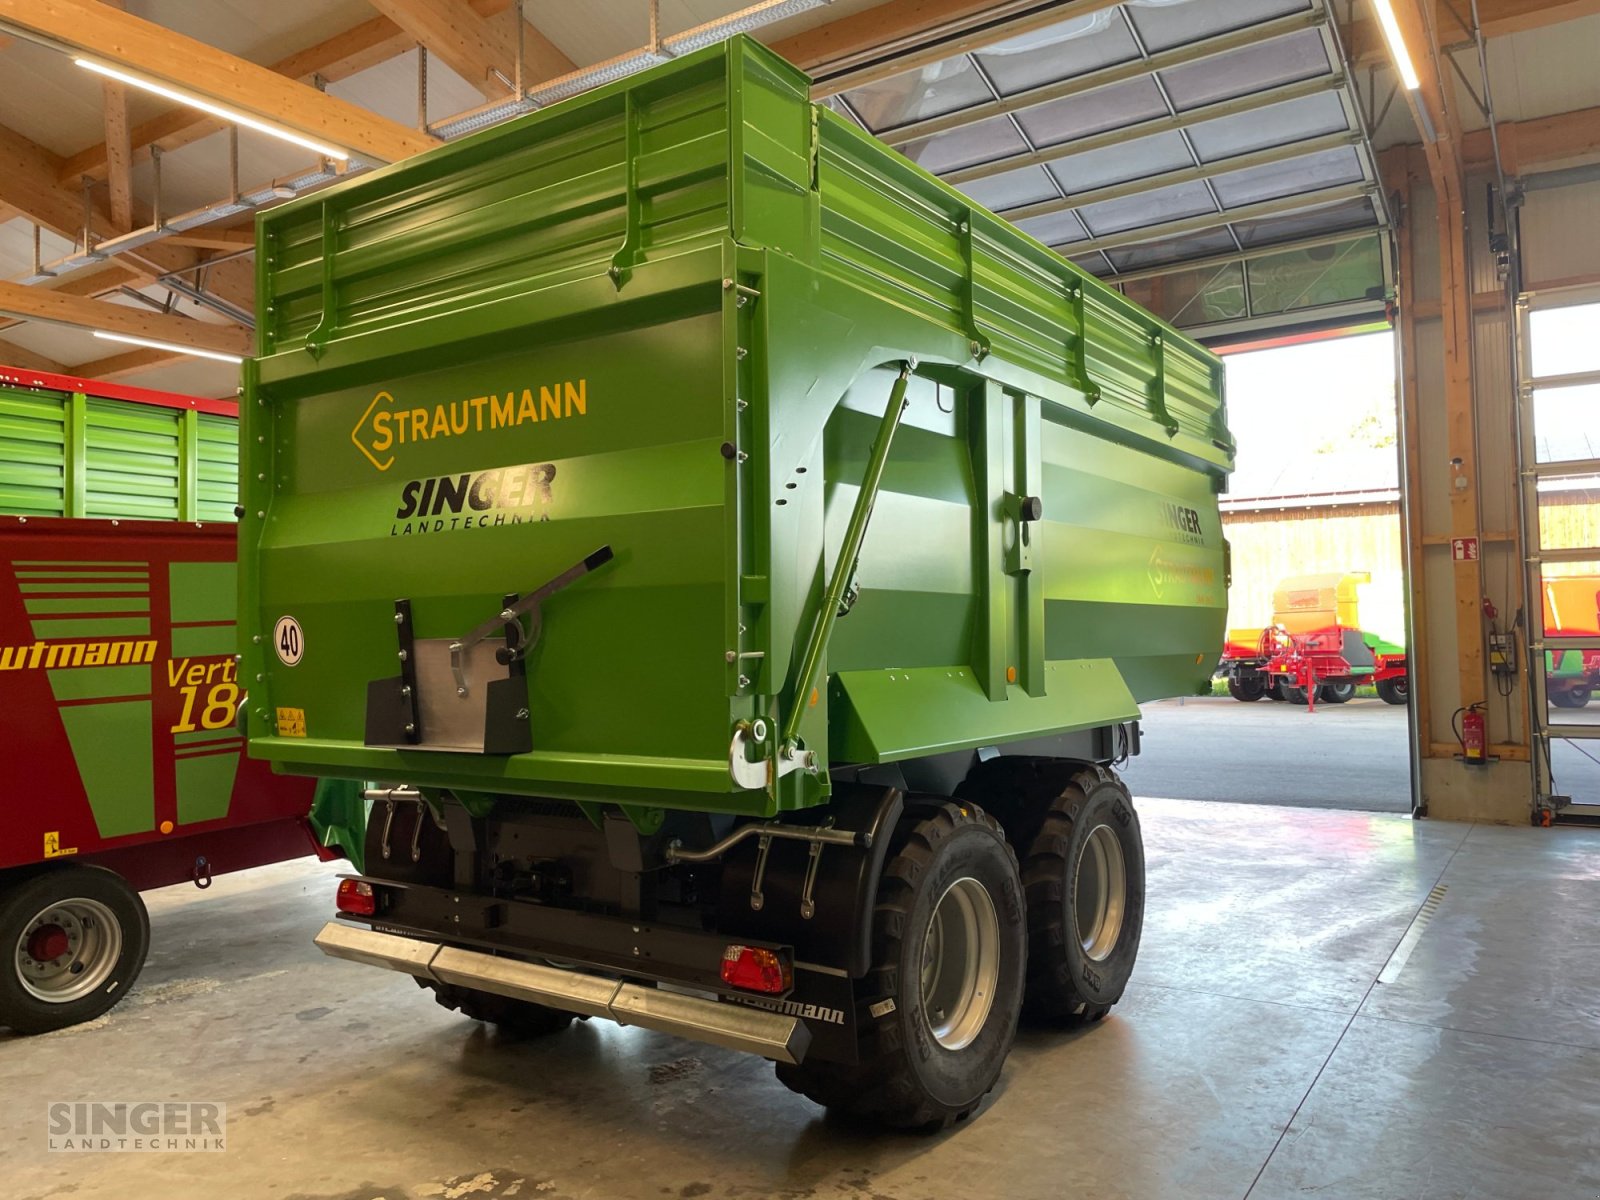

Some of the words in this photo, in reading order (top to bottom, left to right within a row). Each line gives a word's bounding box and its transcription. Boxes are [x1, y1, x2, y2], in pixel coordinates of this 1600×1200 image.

[372, 379, 586, 451] STRAUTMANN
[396, 463, 557, 520] SINGER
[0, 641, 158, 671] utmann
[280, 625, 299, 657] 40
[170, 683, 248, 734] 18
